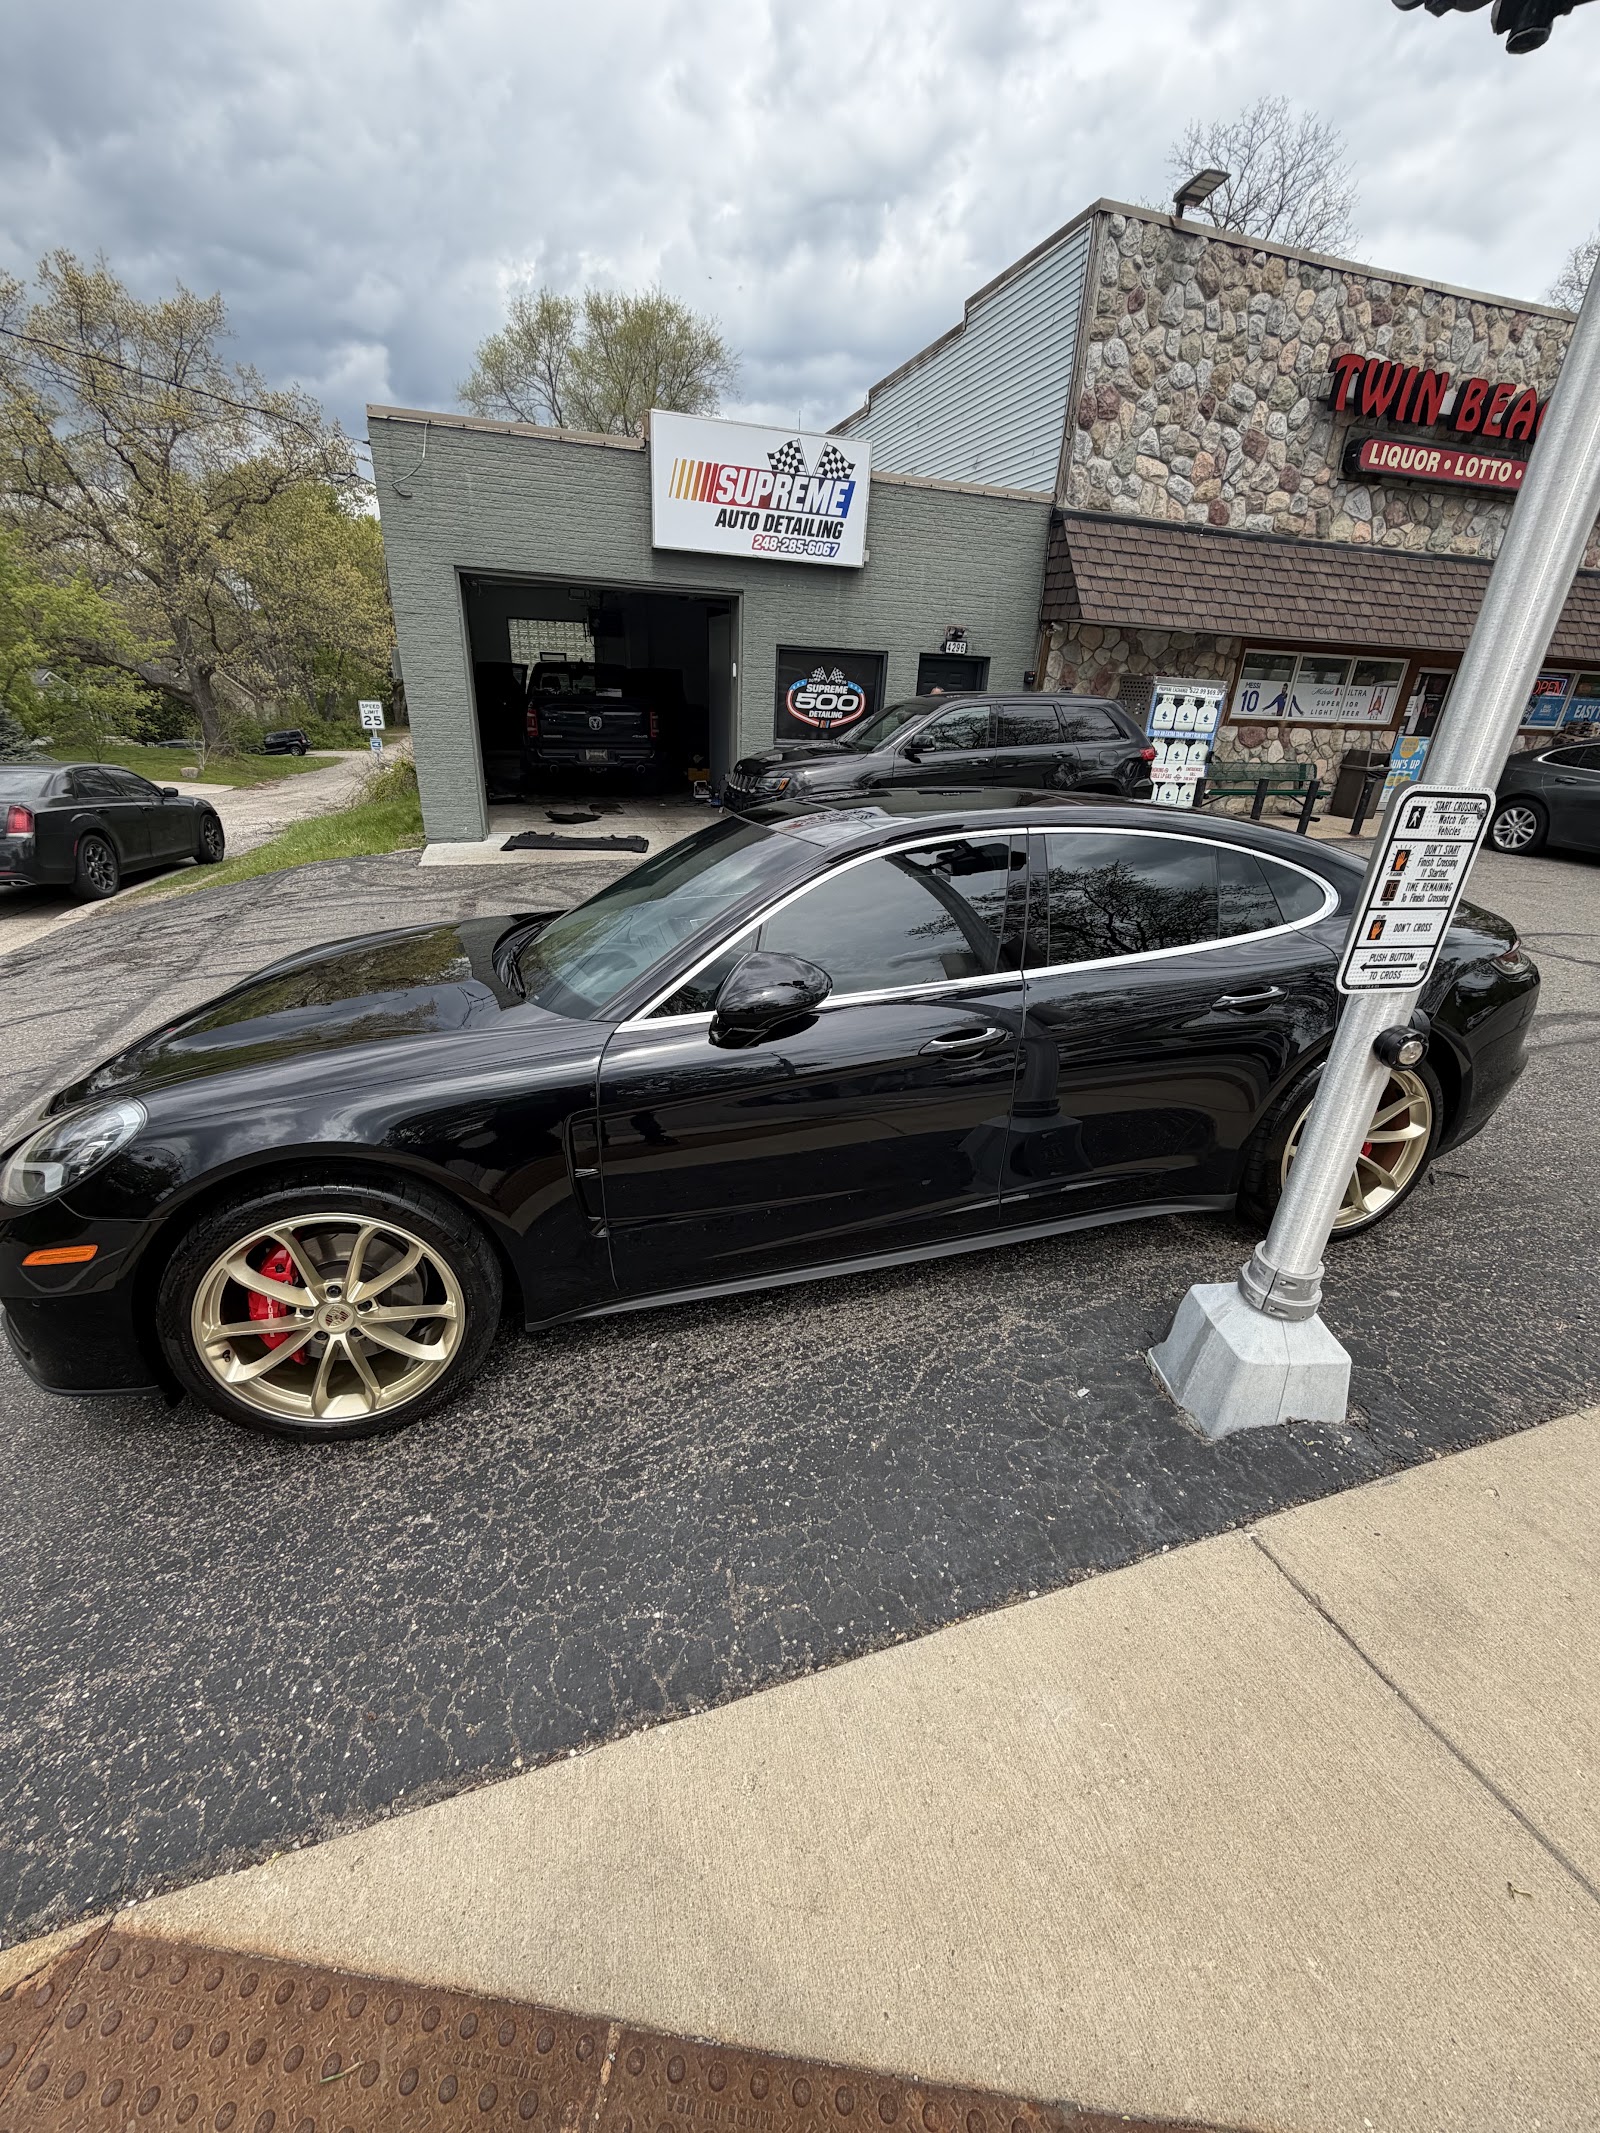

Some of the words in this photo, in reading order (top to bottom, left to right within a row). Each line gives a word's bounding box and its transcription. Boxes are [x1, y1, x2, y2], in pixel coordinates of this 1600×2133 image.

[1329, 353, 1449, 426] TWIN
[1368, 443, 1441, 473] LIQUOR
[1453, 455, 1513, 483] LOTTO
[715, 466, 850, 517] SUPREME
[714, 508, 761, 531] AUTO
[762, 513, 845, 540] DETAILING
[752, 534, 841, 558] 248-285-6067
[947, 642, 965, 653] 4296
[806, 683, 849, 695] SUPREME
[794, 692, 859, 712] 500
[1241, 690, 1259, 712] 10
[1316, 699, 1359, 708] SUPERIOR
[808, 710, 843, 719] DETAILING
[1573, 704, 1597, 719] EASY
[363, 715, 382, 726] 25
[1409, 760, 1421, 770] UP
[1434, 801, 1452, 811] START
[1453, 801, 1482, 812] CROSSING
[1438, 814, 1456, 825] Watch
[1458, 814, 1469, 825] For
[1437, 825, 1461, 836] Vehicles
[1424, 844, 1442, 855] DON'T
[1443, 845, 1461, 855] START
[1417, 857, 1434, 867] Finish
[1436, 857, 1459, 870] Crossing
[1427, 868, 1448, 878] Started
[1405, 882, 1420, 892] TIME
[1421, 882, 1454, 892] REMAINING
[1400, 893, 1408, 903] To
[1409, 893, 1425, 903] Finish
[1427, 893, 1449, 905] Crossing
[1393, 923, 1411, 933] DON'T
[1413, 922, 1433, 932] CROSS
[1368, 953, 1388, 962] PUSH
[1389, 952, 1416, 962] BUTTON
[1369, 971, 1379, 981] TO
[1379, 970, 1403, 980] CROSS
[665, 2093, 697, 2117] USA
[703, 2099, 721, 2121] IN
[727, 2104, 775, 2131] MADE
